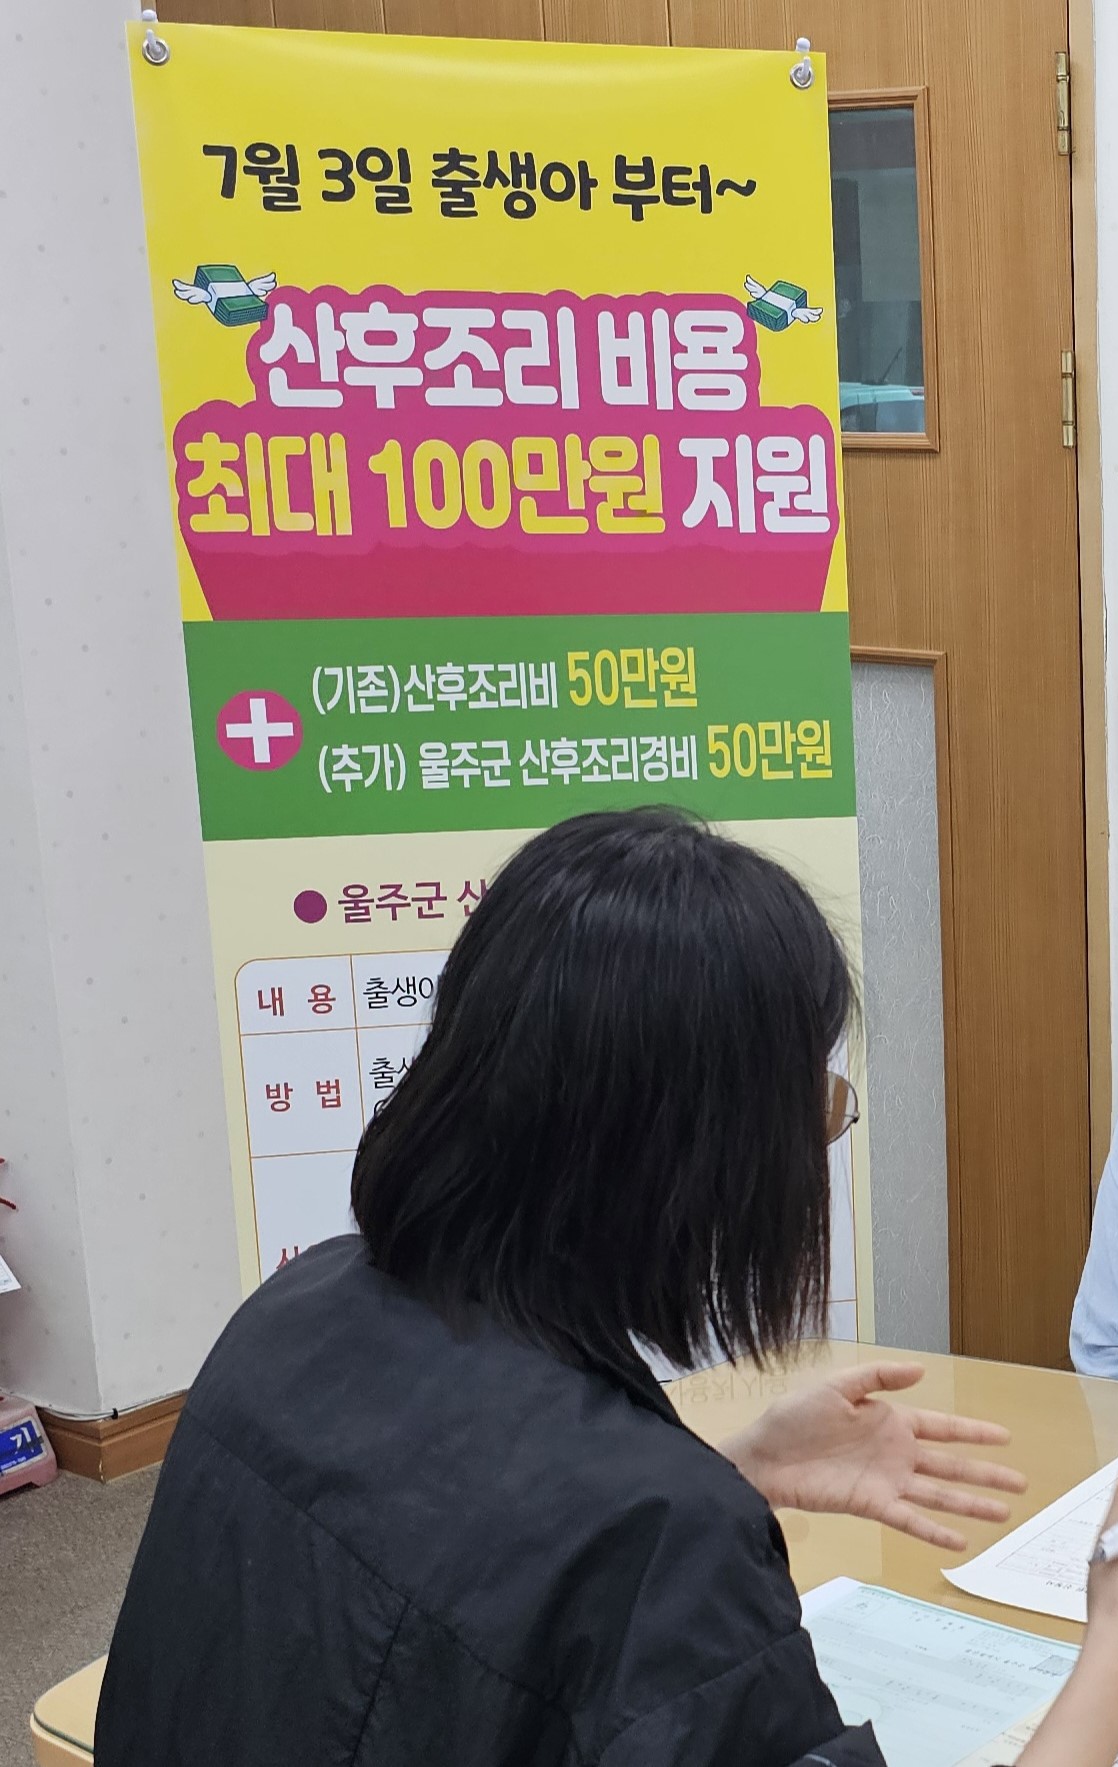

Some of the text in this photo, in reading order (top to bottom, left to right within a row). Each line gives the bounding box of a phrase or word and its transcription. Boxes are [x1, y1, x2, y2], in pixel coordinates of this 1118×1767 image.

[203, 143, 757, 221] 7월 3일 출생아 부터~
[258, 302, 748, 411] 산후조리 비용
[184, 432, 831, 535] 최대 100만원 지원
[568, 647, 698, 708] 50만원
[319, 721, 833, 793] (추가) 울주군 산후조리경비 50만원
[338, 881, 448, 924] 울주군
